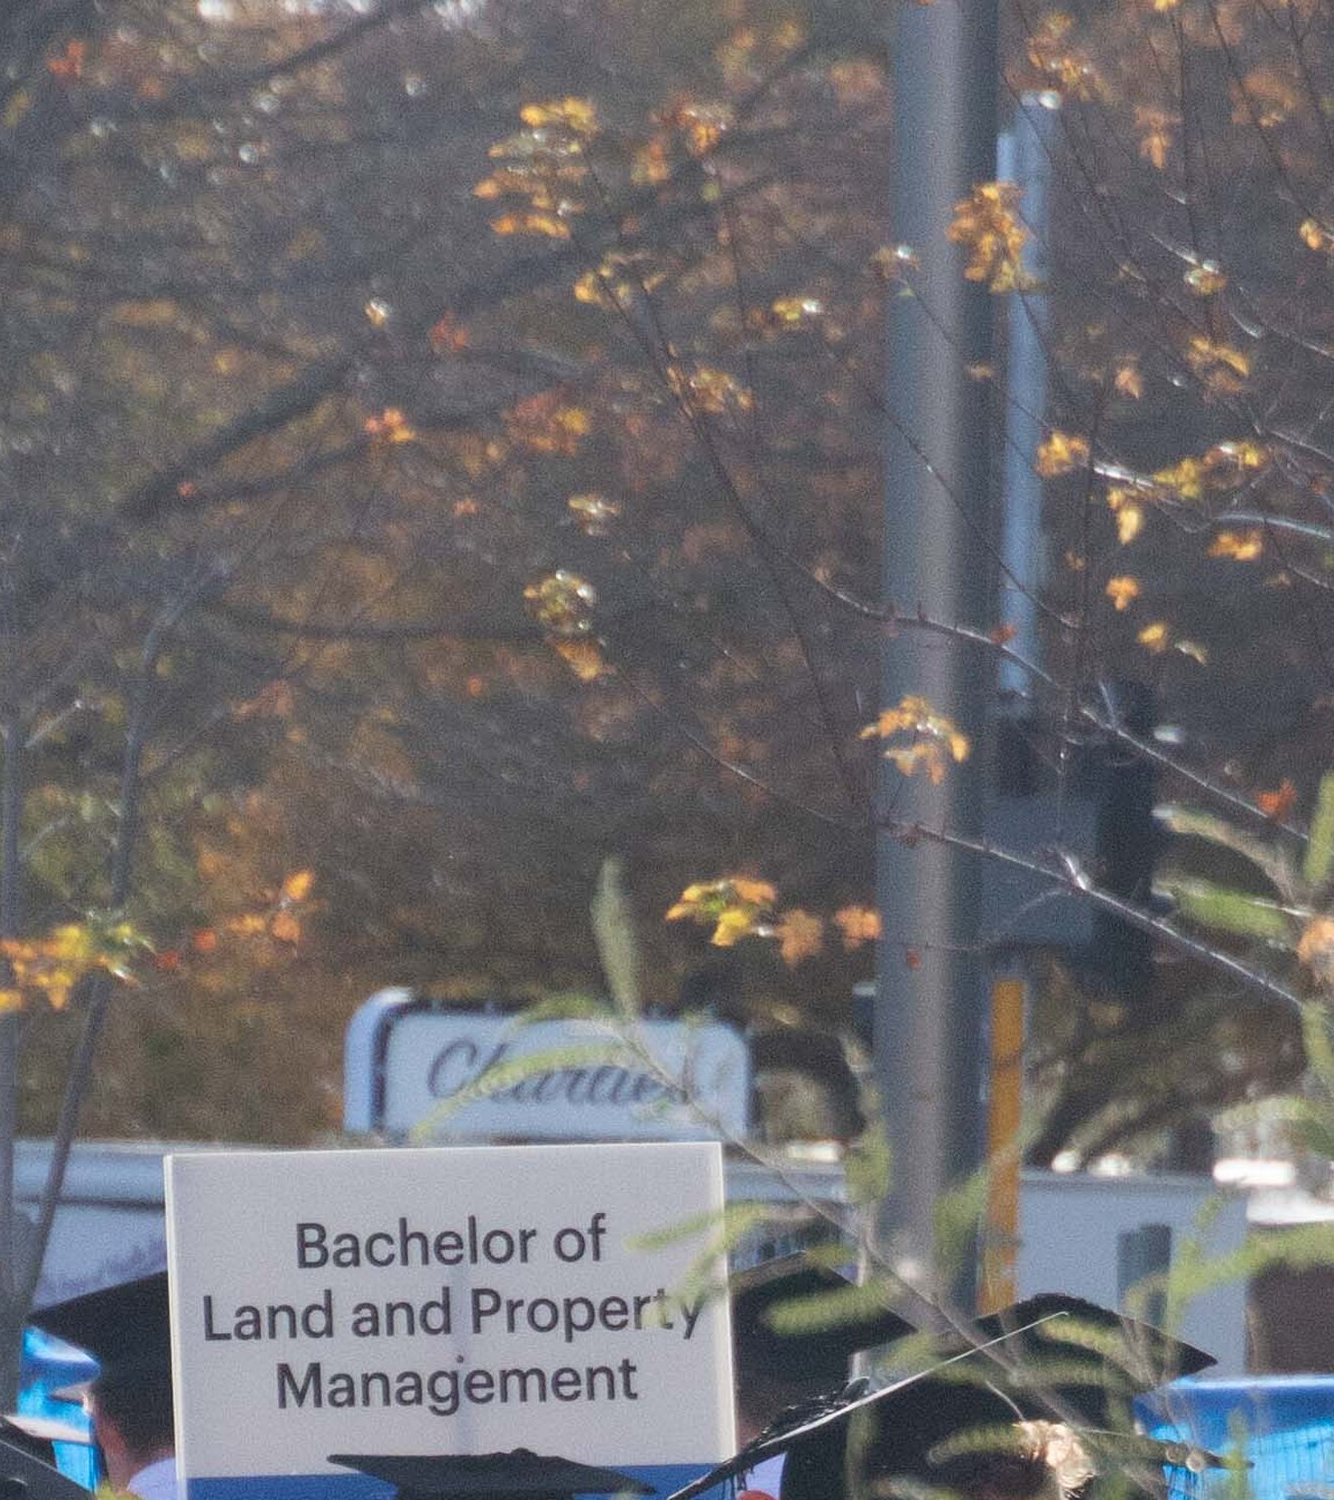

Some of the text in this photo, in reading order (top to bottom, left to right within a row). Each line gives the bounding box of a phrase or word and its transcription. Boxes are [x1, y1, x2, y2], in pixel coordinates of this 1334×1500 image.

[295, 1212, 606, 1269] Bachelor of
[202, 1285, 706, 1343] Land and Property
[276, 1358, 639, 1417] Management
